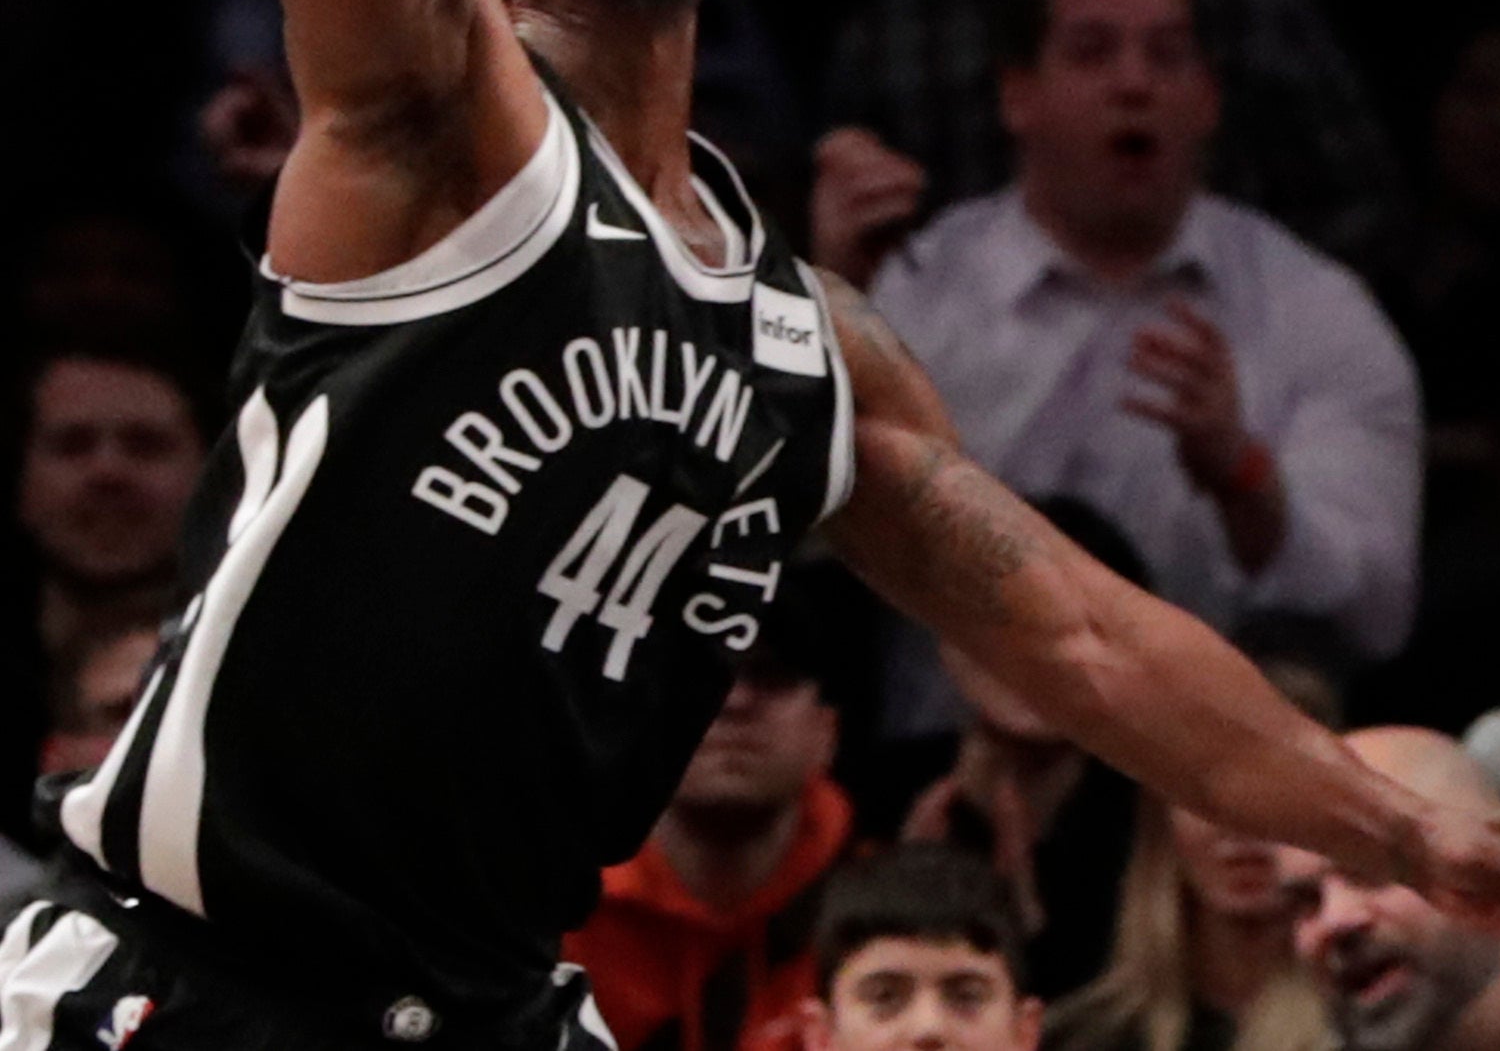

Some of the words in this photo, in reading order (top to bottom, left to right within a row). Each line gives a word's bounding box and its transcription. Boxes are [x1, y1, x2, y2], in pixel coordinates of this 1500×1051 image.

[412, 326, 753, 535] BROOKLYN
[759, 311, 813, 345] infor
[537, 473, 708, 681] 44
[683, 438, 785, 650] ETS
